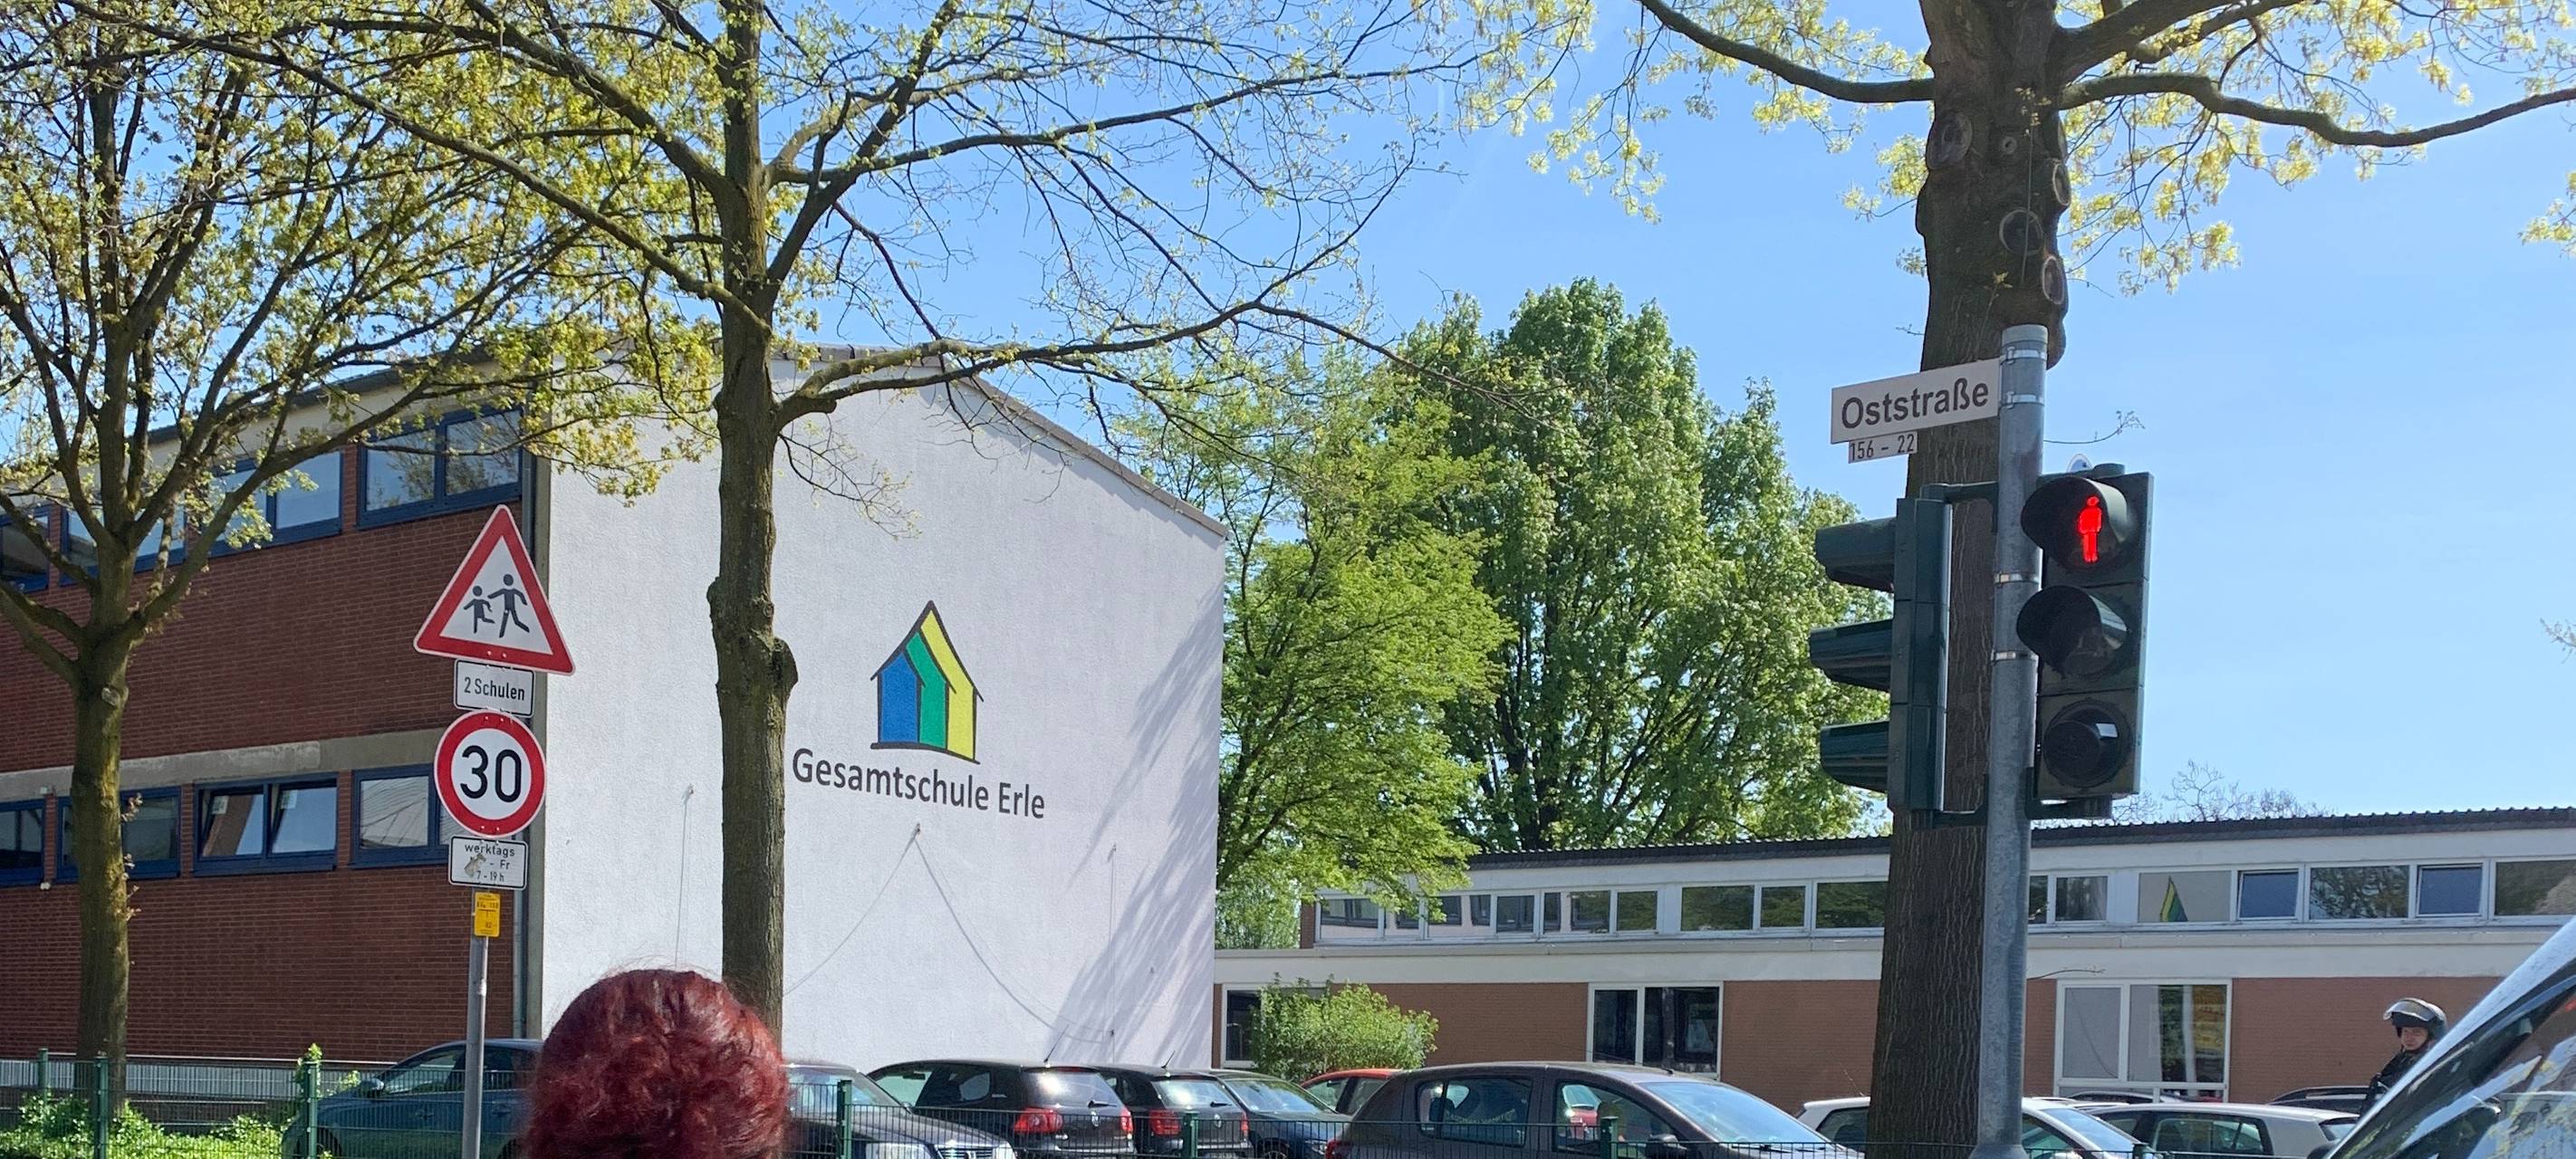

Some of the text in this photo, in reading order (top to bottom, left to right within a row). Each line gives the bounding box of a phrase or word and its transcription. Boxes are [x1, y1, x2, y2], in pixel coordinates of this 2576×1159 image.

[1841, 377, 1989, 429] Oststraße
[1850, 439, 1874, 461] 156
[1897, 433, 1915, 454] 22
[464, 676, 525, 701] 2 Schulen
[460, 745, 522, 802] 30
[793, 747, 1045, 819] Gesamtschule Erle
[465, 843, 515, 858] werktags
[500, 859, 510, 869] Fr
